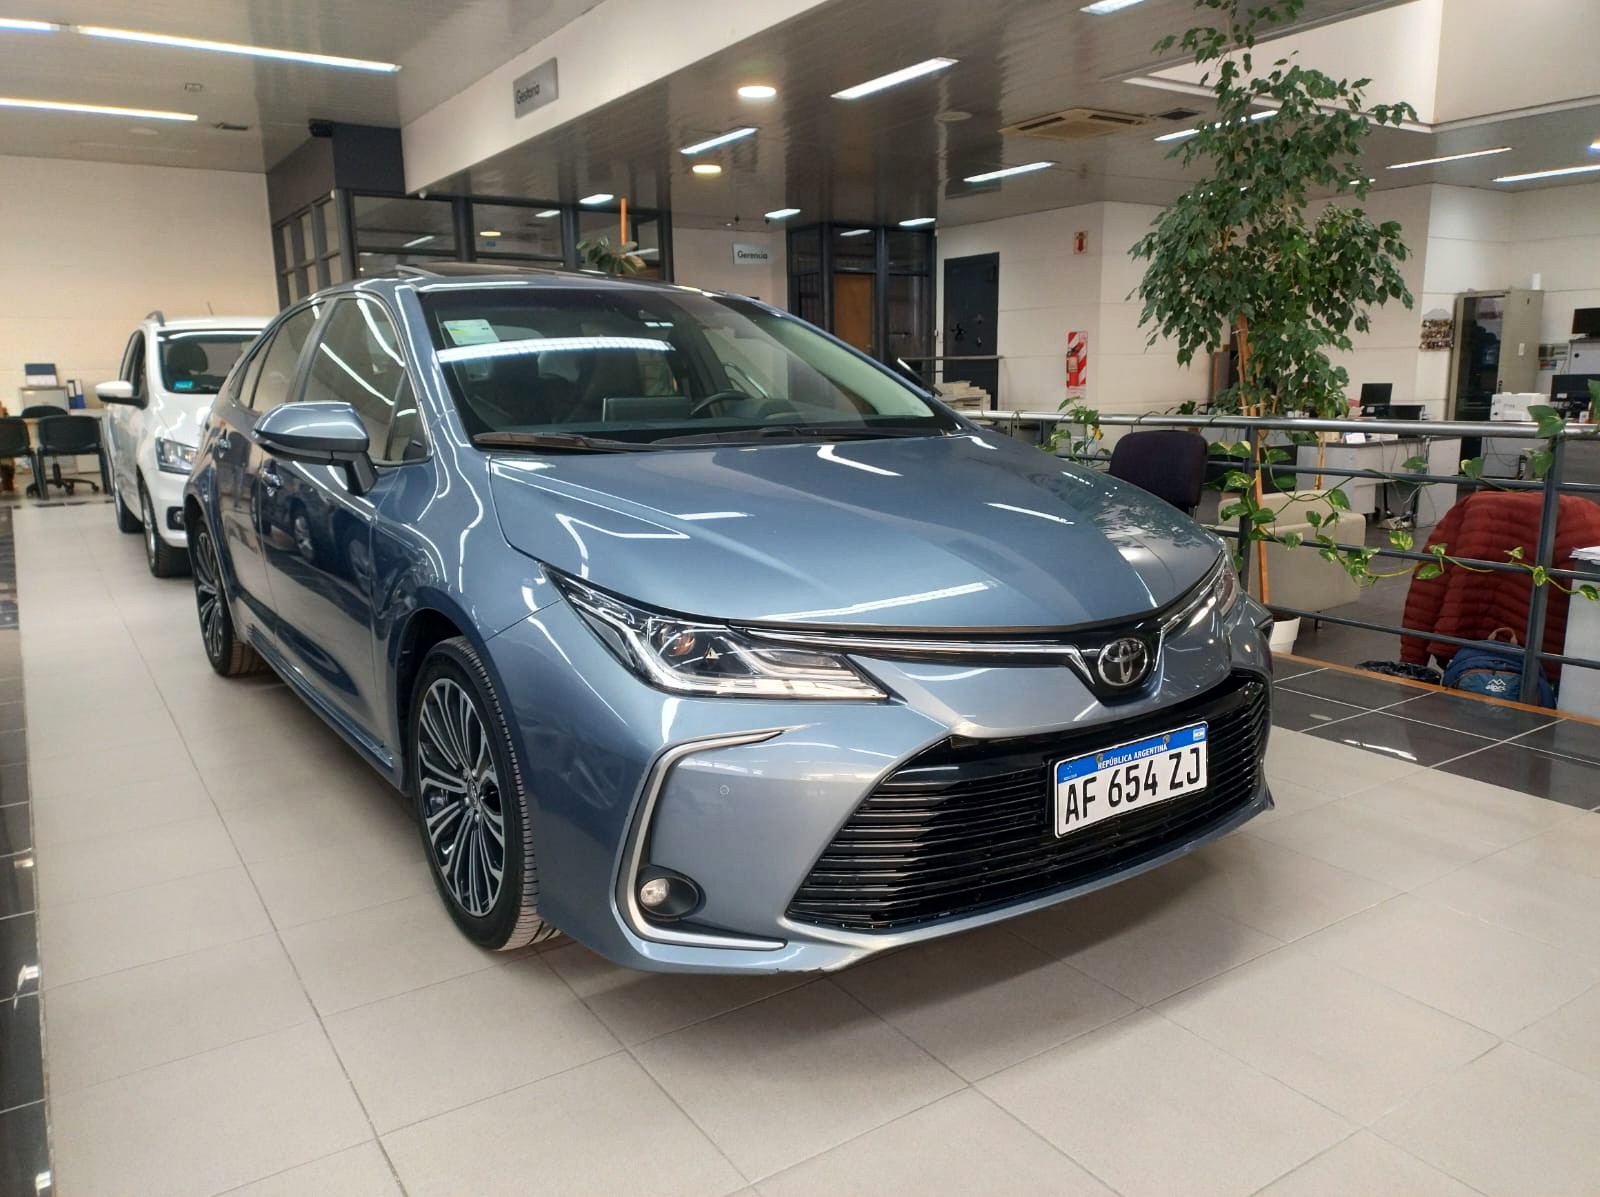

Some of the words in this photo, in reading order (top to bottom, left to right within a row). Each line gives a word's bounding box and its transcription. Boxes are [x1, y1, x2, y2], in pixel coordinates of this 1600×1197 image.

[737, 250, 768, 260] Gerencia
[1097, 754, 1132, 770] REPÚBLICA
[1133, 743, 1168, 760] ARGENTINA
[1065, 776, 1097, 825] AF
[1108, 759, 1158, 808] 654
[1168, 747, 1200, 791] ZJ
